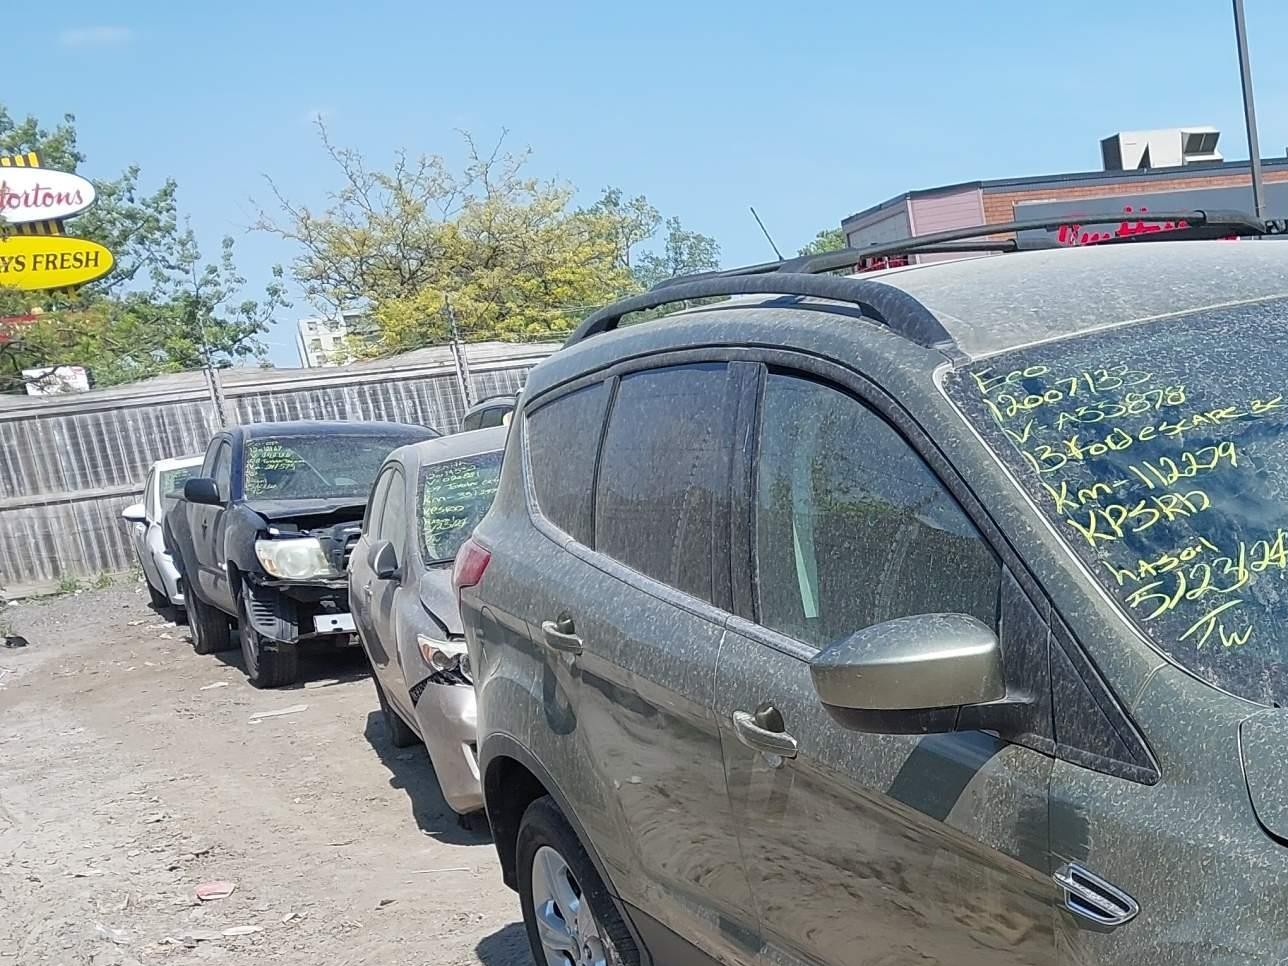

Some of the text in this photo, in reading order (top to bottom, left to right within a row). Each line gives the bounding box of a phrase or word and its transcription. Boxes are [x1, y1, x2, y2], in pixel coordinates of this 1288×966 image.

[0, 250, 100, 273] YS FRESH
[983, 362, 1152, 422] 12007133
